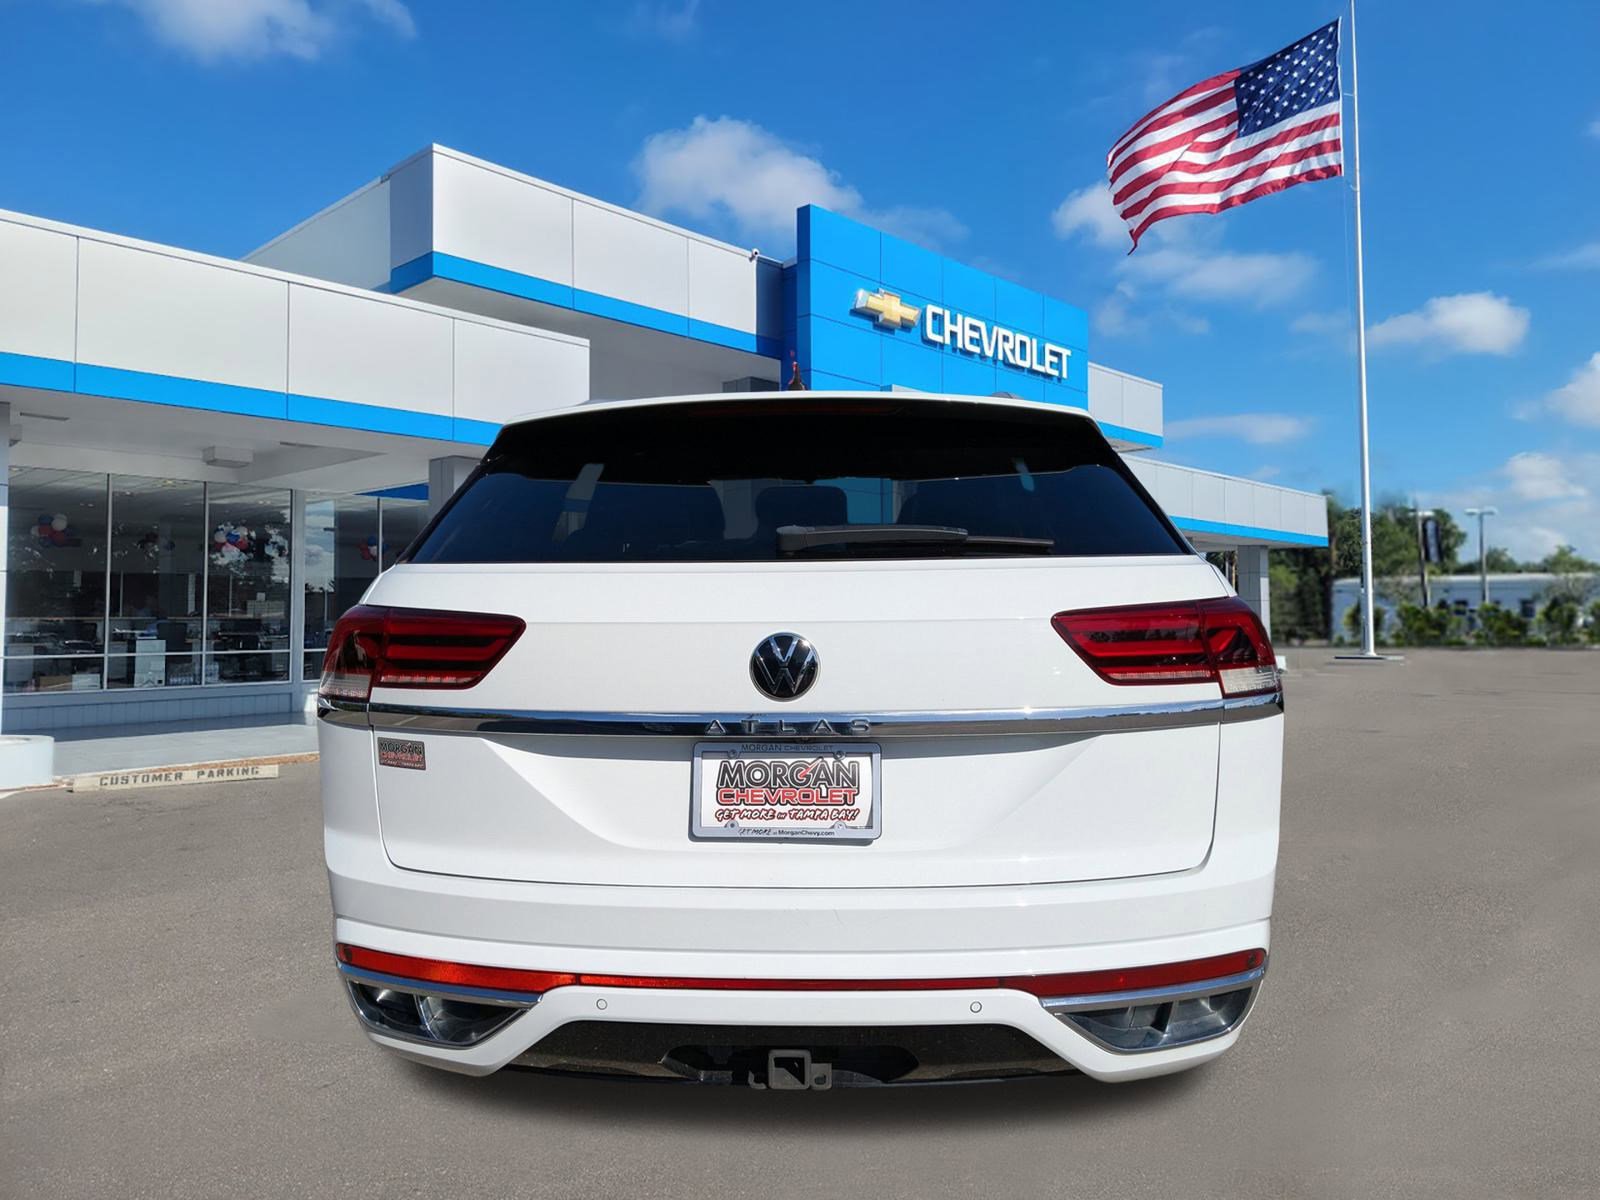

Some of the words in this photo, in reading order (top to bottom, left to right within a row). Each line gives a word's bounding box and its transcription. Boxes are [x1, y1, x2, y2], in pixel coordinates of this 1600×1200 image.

[926, 304, 1072, 379] CHEVROLET
[705, 719, 870, 735] ATLAS
[380, 742, 423, 755] MORGAN
[741, 743, 781, 752] MORGAN
[99, 772, 183, 786] CUSTOMER
[197, 766, 259, 779] PARKING
[717, 759, 859, 788] MORGAN
[716, 788, 859, 806] CHEVROLET
[715, 809, 739, 821] GET
[740, 808, 775, 820] MORE
[789, 808, 829, 820] TAMPA
[831, 809, 860, 820] BAY!
